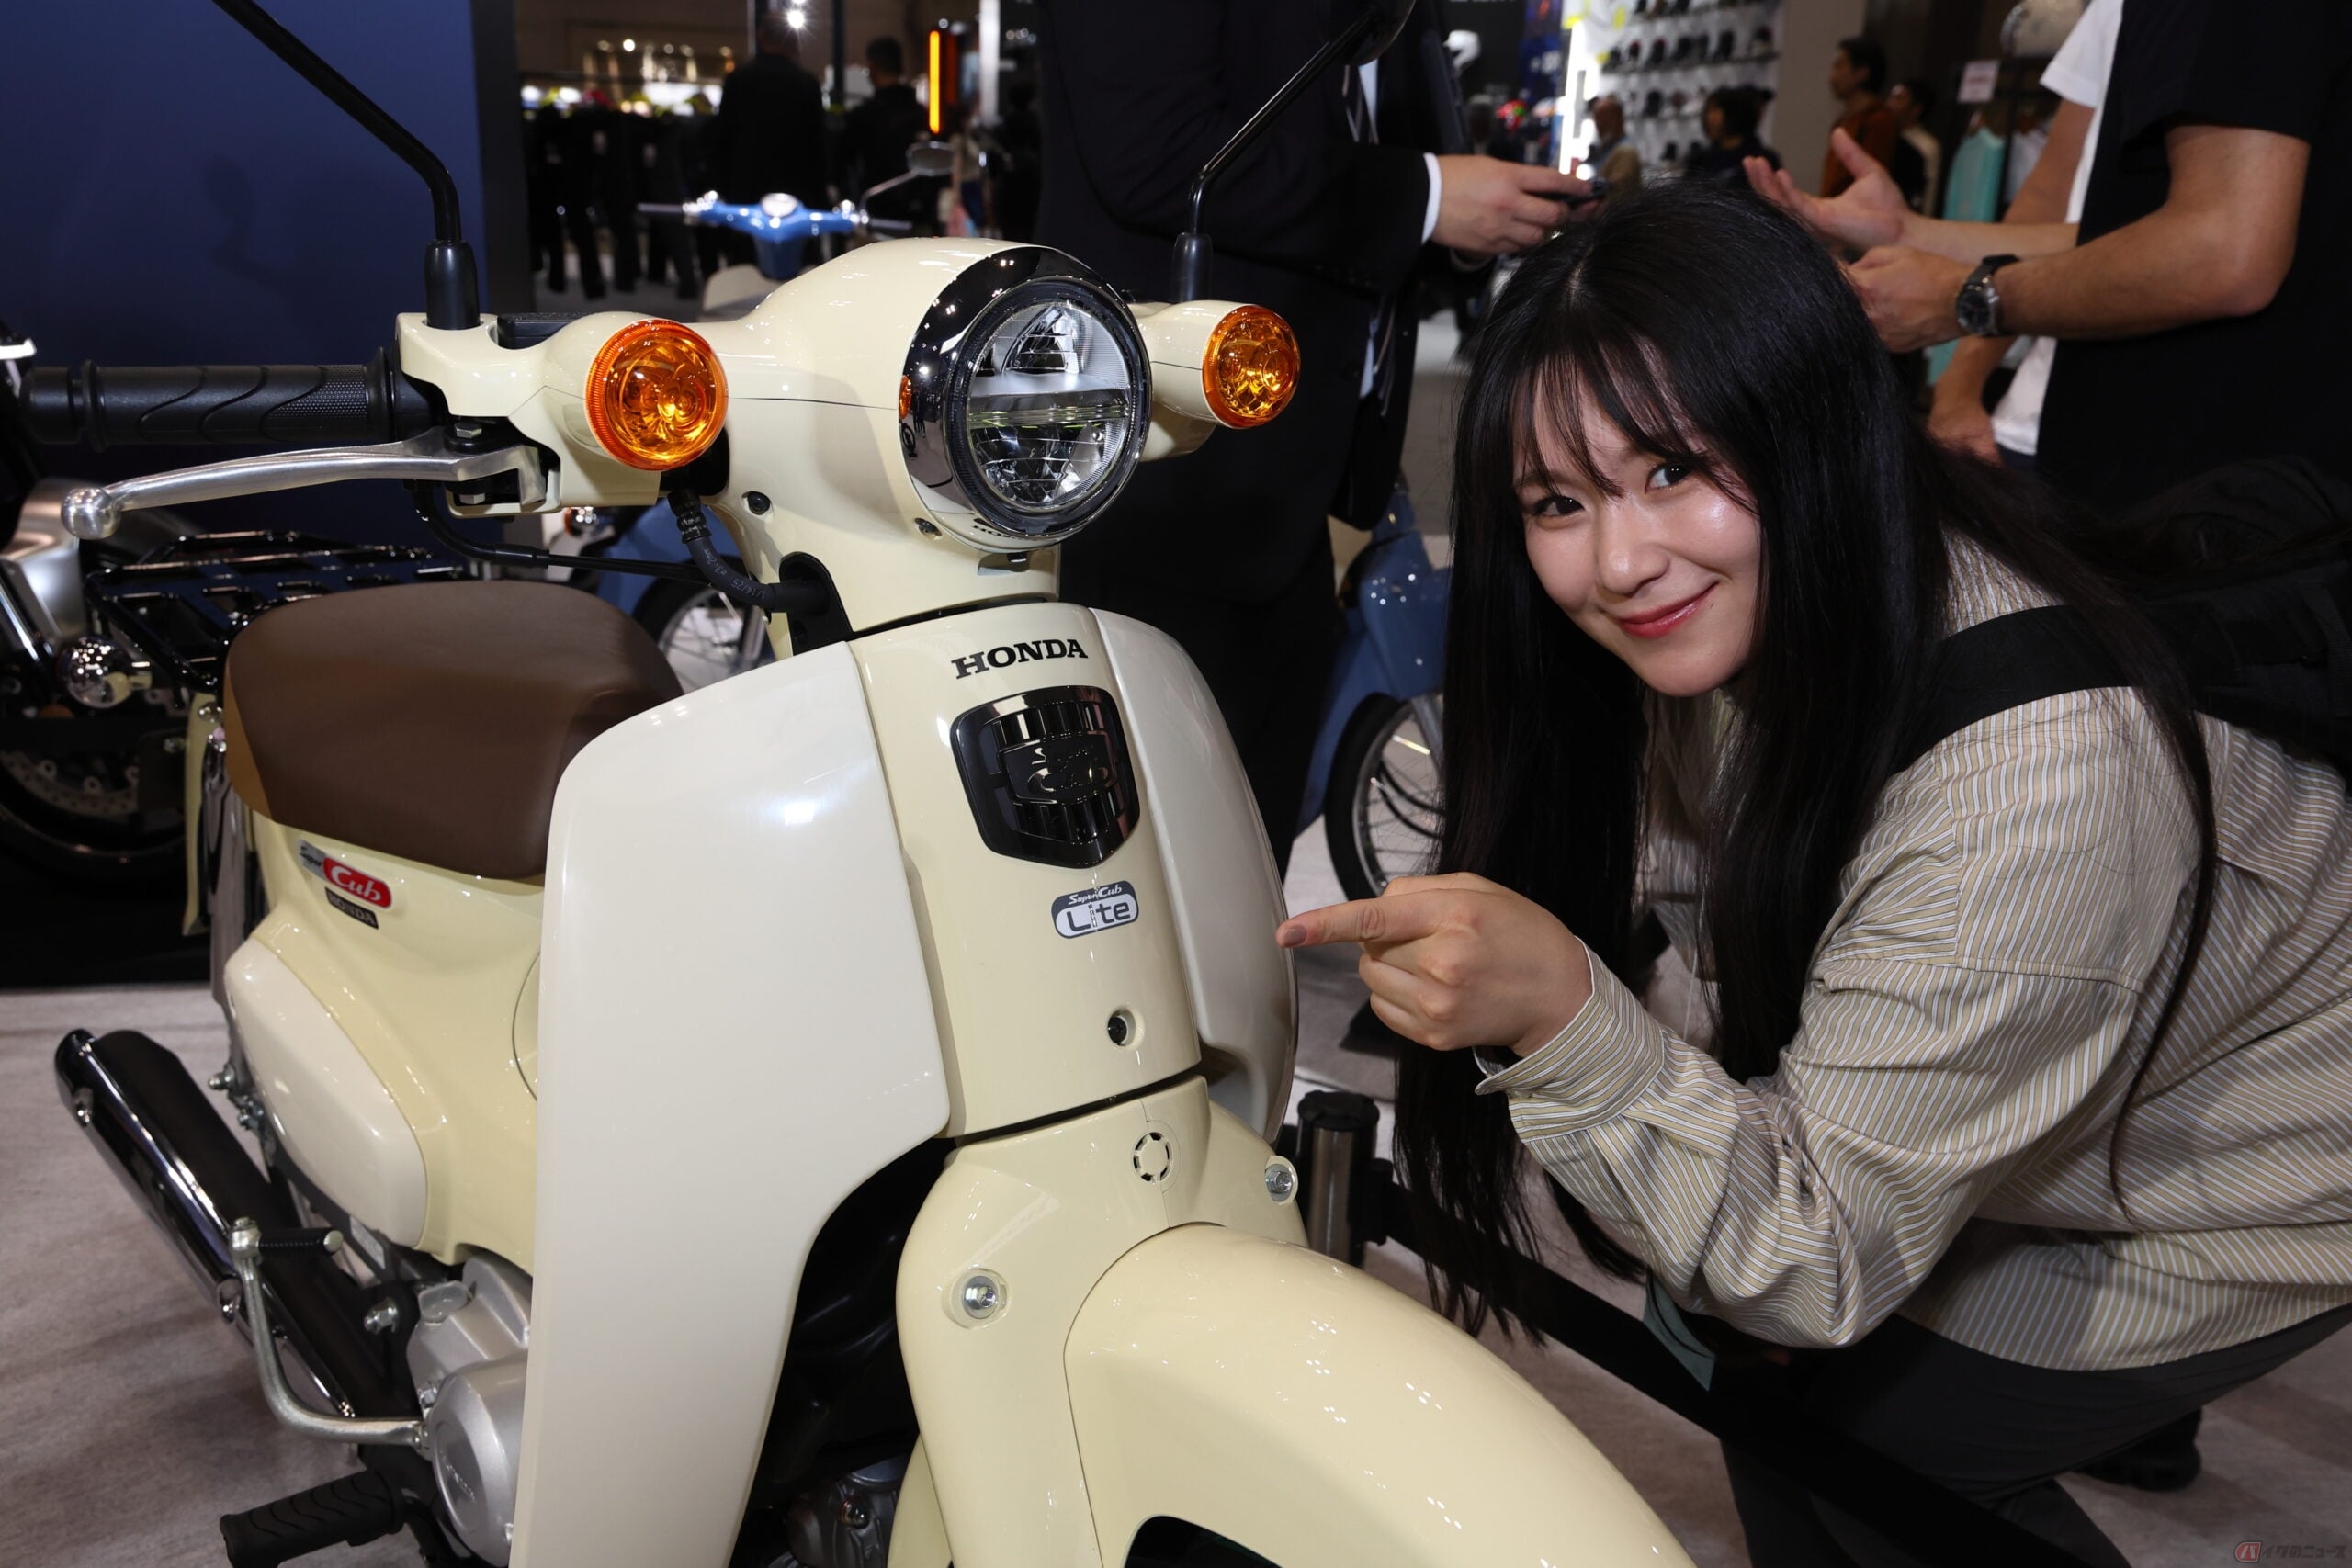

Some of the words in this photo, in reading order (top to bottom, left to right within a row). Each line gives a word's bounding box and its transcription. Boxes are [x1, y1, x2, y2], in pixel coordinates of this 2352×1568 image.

[951, 639, 1089, 679] HONDA
[331, 865, 381, 900] Cub
[1067, 902, 1131, 931] Lite
